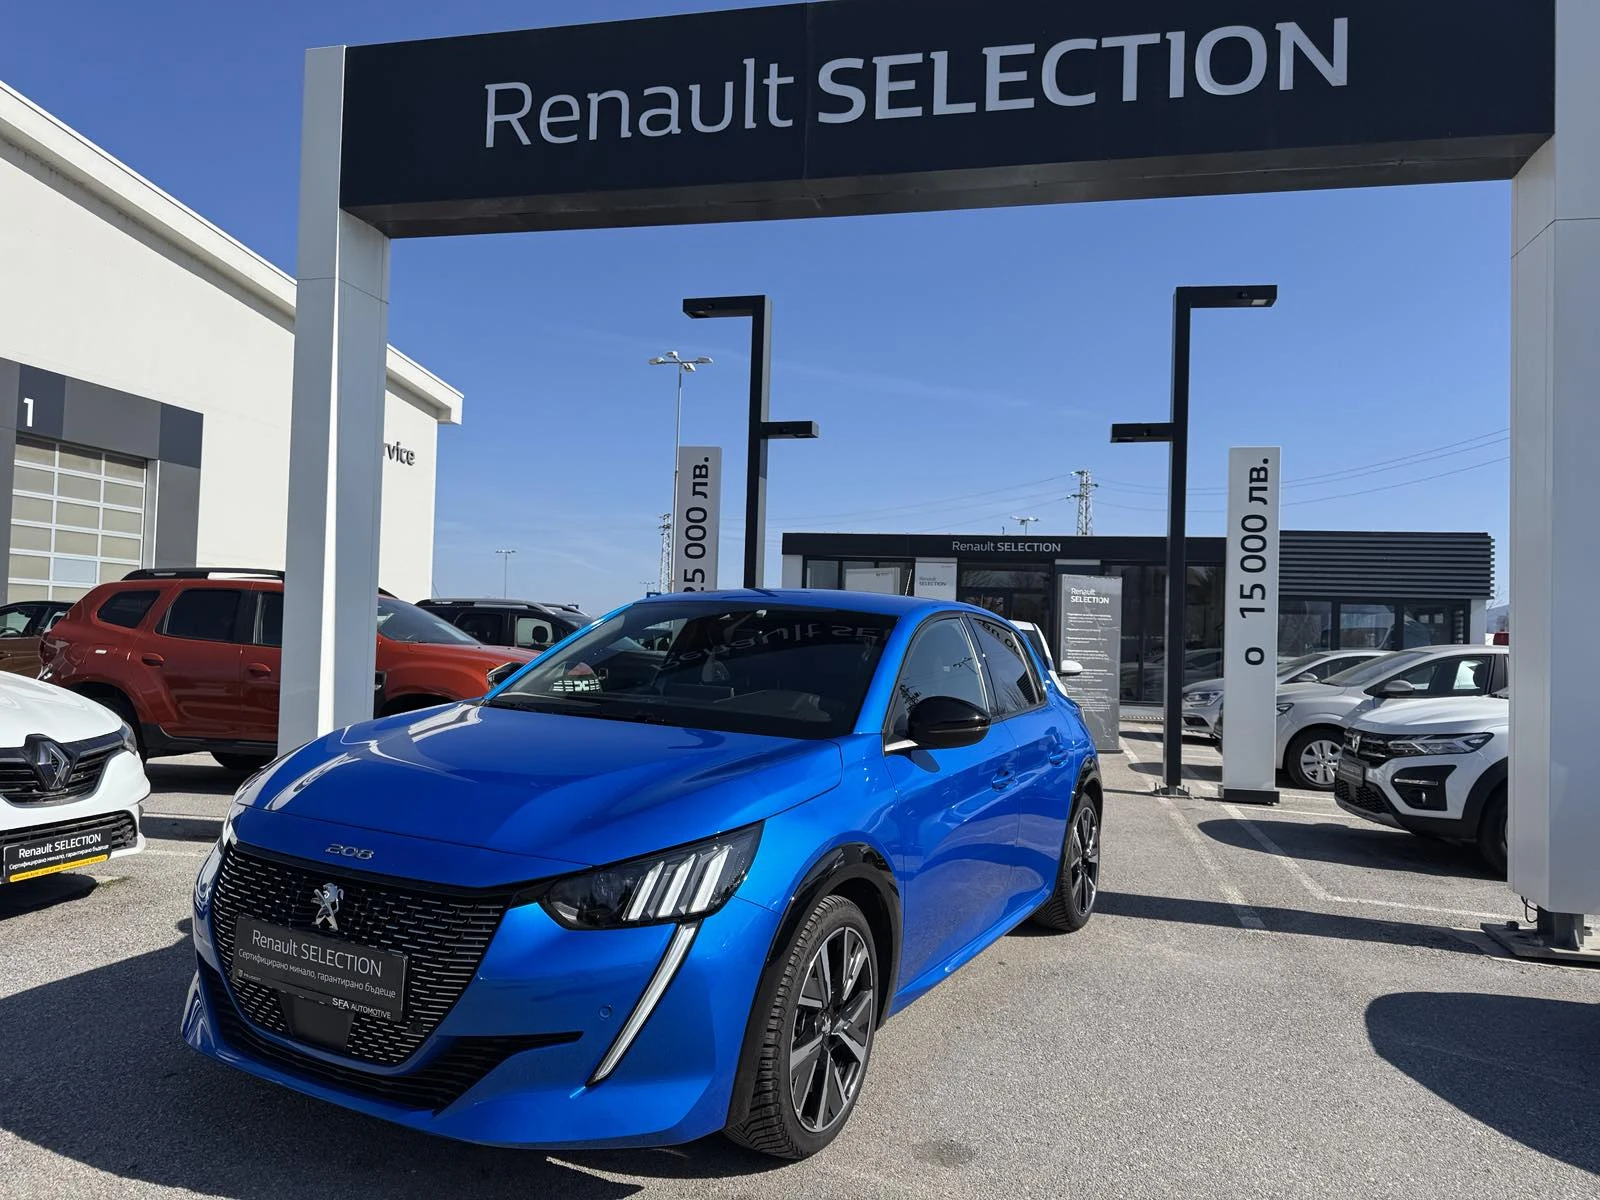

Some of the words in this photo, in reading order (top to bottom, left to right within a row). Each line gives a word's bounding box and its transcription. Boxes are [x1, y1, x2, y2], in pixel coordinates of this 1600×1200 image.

[484, 58, 795, 148] Renault
[817, 17, 1349, 124] SELECTION
[23, 397, 34, 427] 1
[692, 456, 710, 499] лв.
[1248, 458, 1269, 505] лв.
[684, 506, 708, 560] 000
[952, 541, 994, 552] Renault
[997, 542, 1061, 553] SELECTION
[1239, 514, 1268, 573] 000
[1070, 587, 1096, 596] Renault
[1070, 595, 1110, 604] SELECTION
[1239, 583, 1266, 619] 15
[19, 842, 53, 858] Renault
[54, 833, 101, 851] SELECTION
[325, 843, 374, 860] 208
[252, 929, 298, 957] Renault
[301, 943, 382, 978] SELECTION
[238, 948, 289, 971] Сертифицирано
[289, 964, 317, 980] минало,
[317, 972, 364, 990] гарантирано
[364, 982, 396, 999] бъдеще
[332, 997, 350, 1009] SFA
[350, 1003, 392, 1019] AUTOMOTIVE
